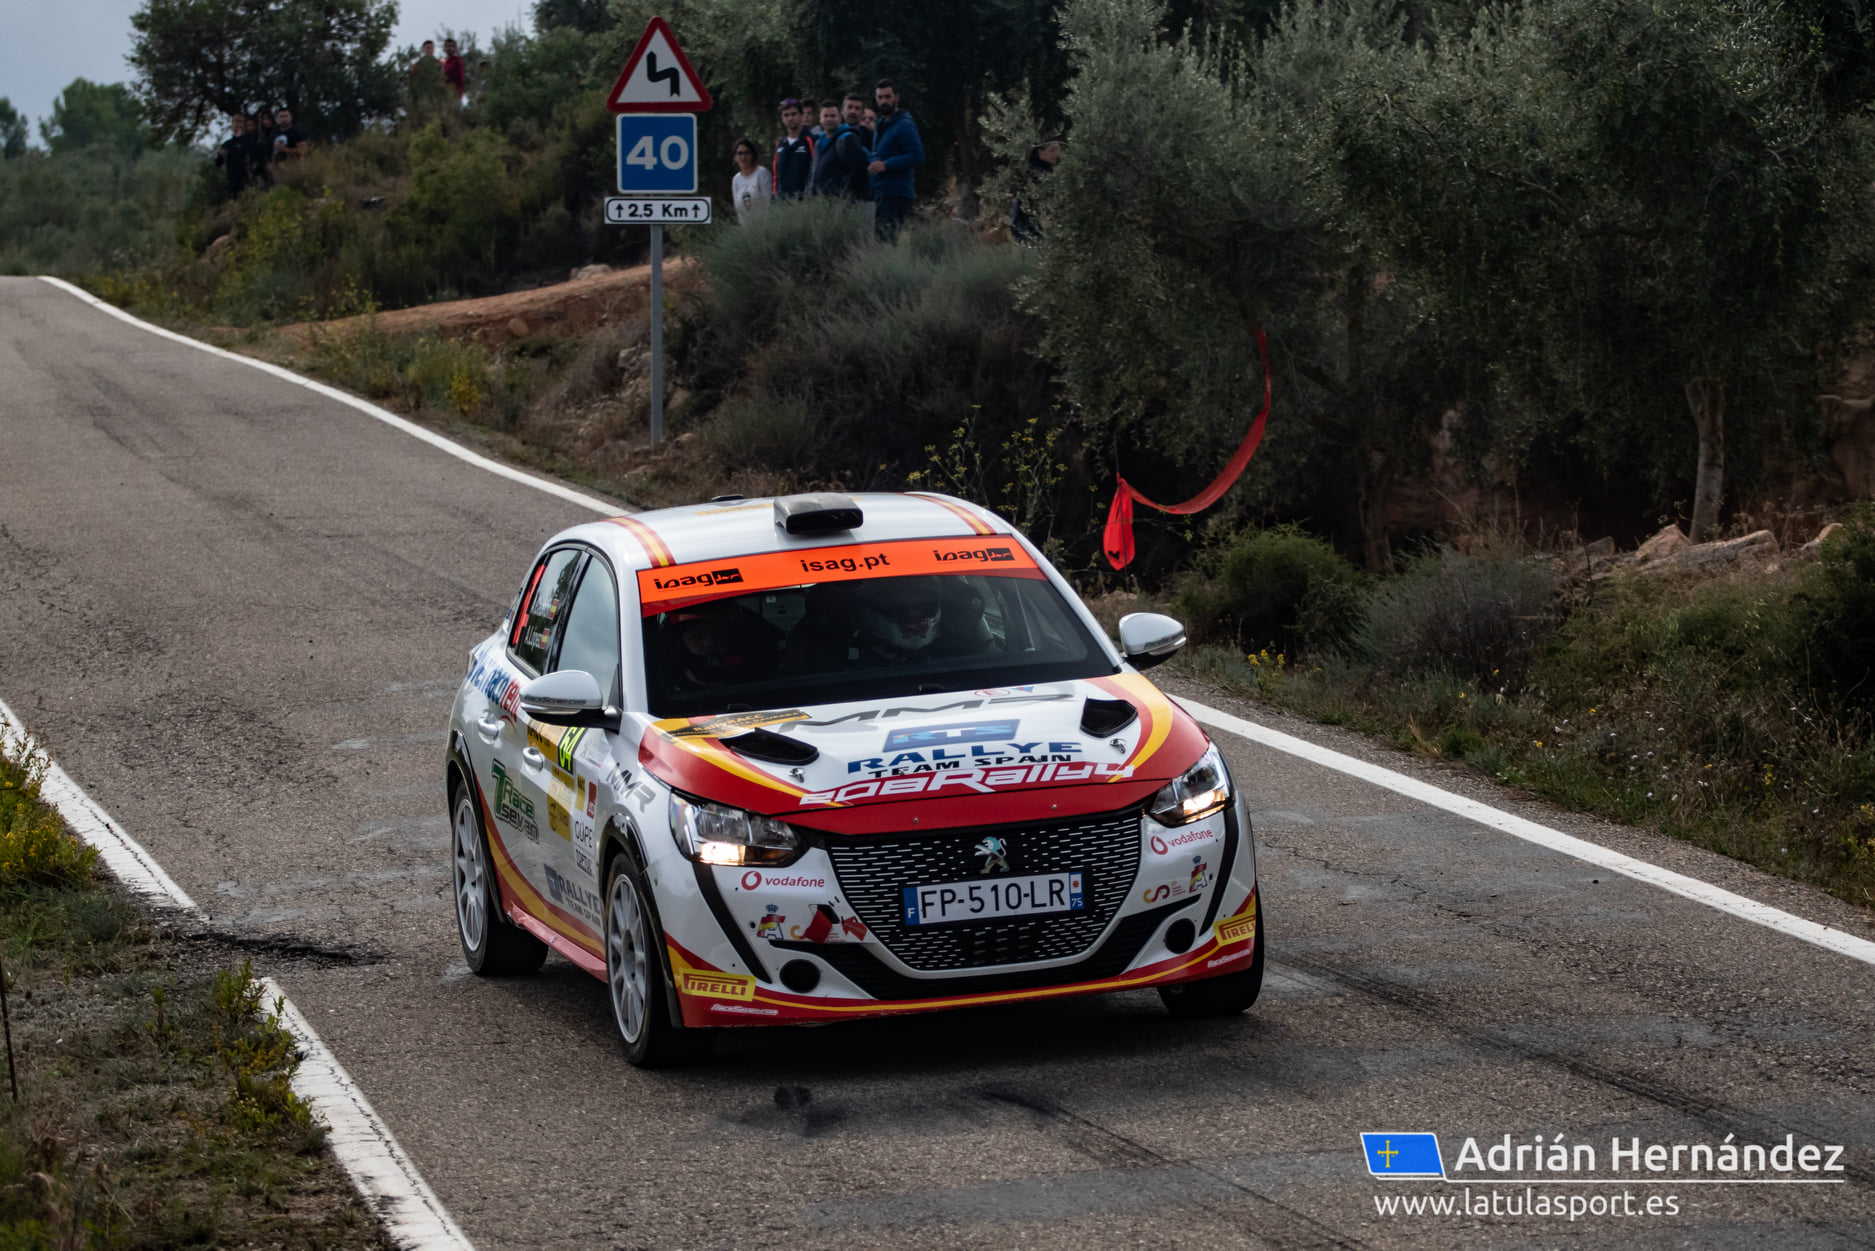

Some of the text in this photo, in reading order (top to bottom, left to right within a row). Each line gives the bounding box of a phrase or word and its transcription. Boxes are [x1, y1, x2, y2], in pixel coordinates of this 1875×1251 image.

[626, 135, 689, 170] 40
[628, 203, 688, 218] 2,5 Km
[800, 553, 890, 572] isag.pt
[892, 724, 1014, 744] RTS
[847, 741, 1083, 774] RALLYE
[868, 753, 1072, 778] TEAM SPAIN
[1167, 828, 1214, 848] vodafone
[765, 876, 825, 888] vodafone
[557, 873, 601, 916] RALLYE
[920, 878, 1066, 919] FP-510-LR
[1072, 897, 1083, 908] 75
[907, 908, 916, 919] F
[683, 973, 748, 996] PIRELLI
